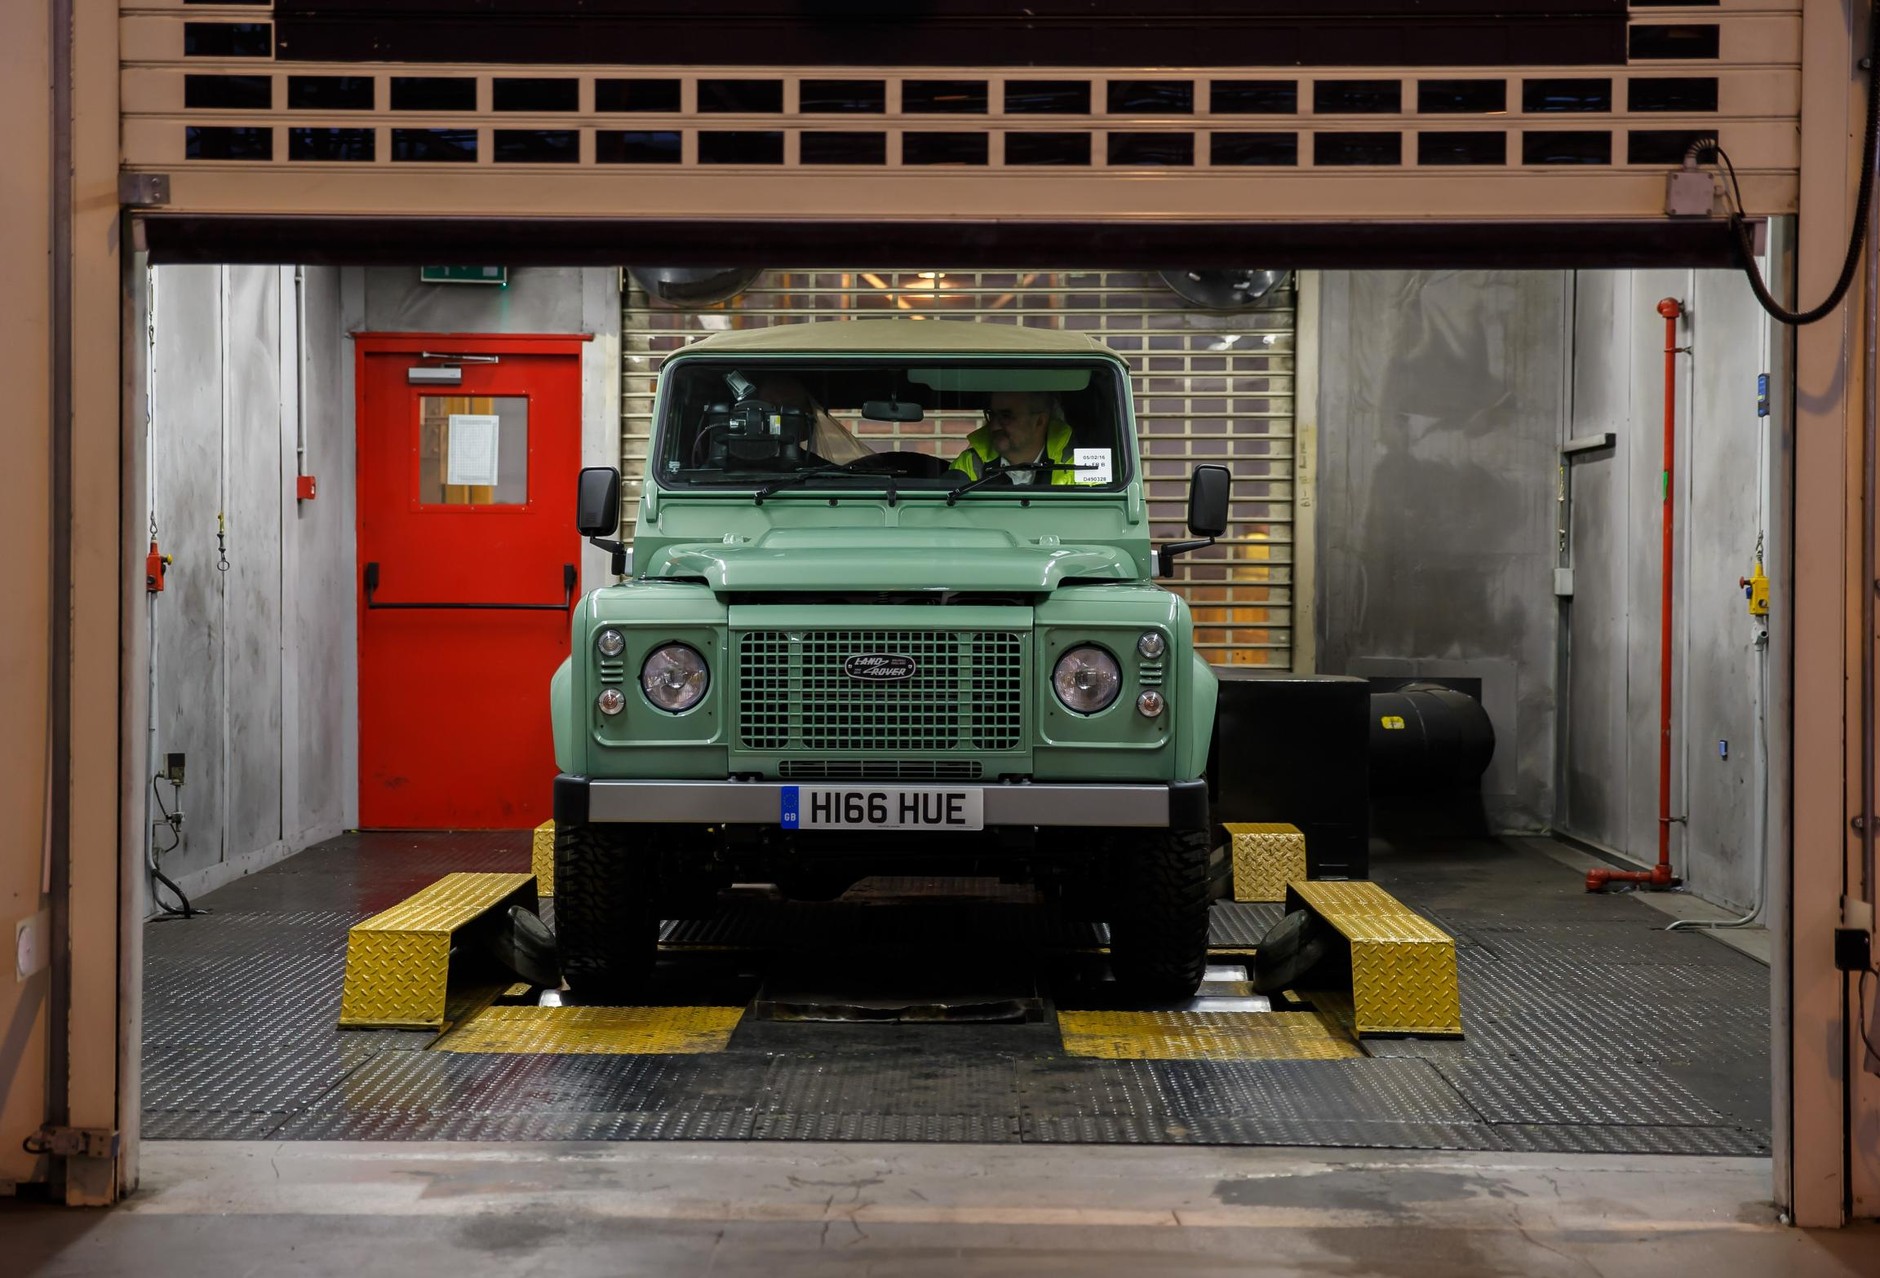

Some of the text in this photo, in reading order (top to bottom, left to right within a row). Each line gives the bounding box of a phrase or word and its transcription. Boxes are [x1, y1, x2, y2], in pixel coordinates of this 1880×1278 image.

[854, 657, 883, 666] LAND
[870, 668, 906, 676] ROVER
[899, 793, 967, 825] HUE
[784, 813, 796, 822] GB
